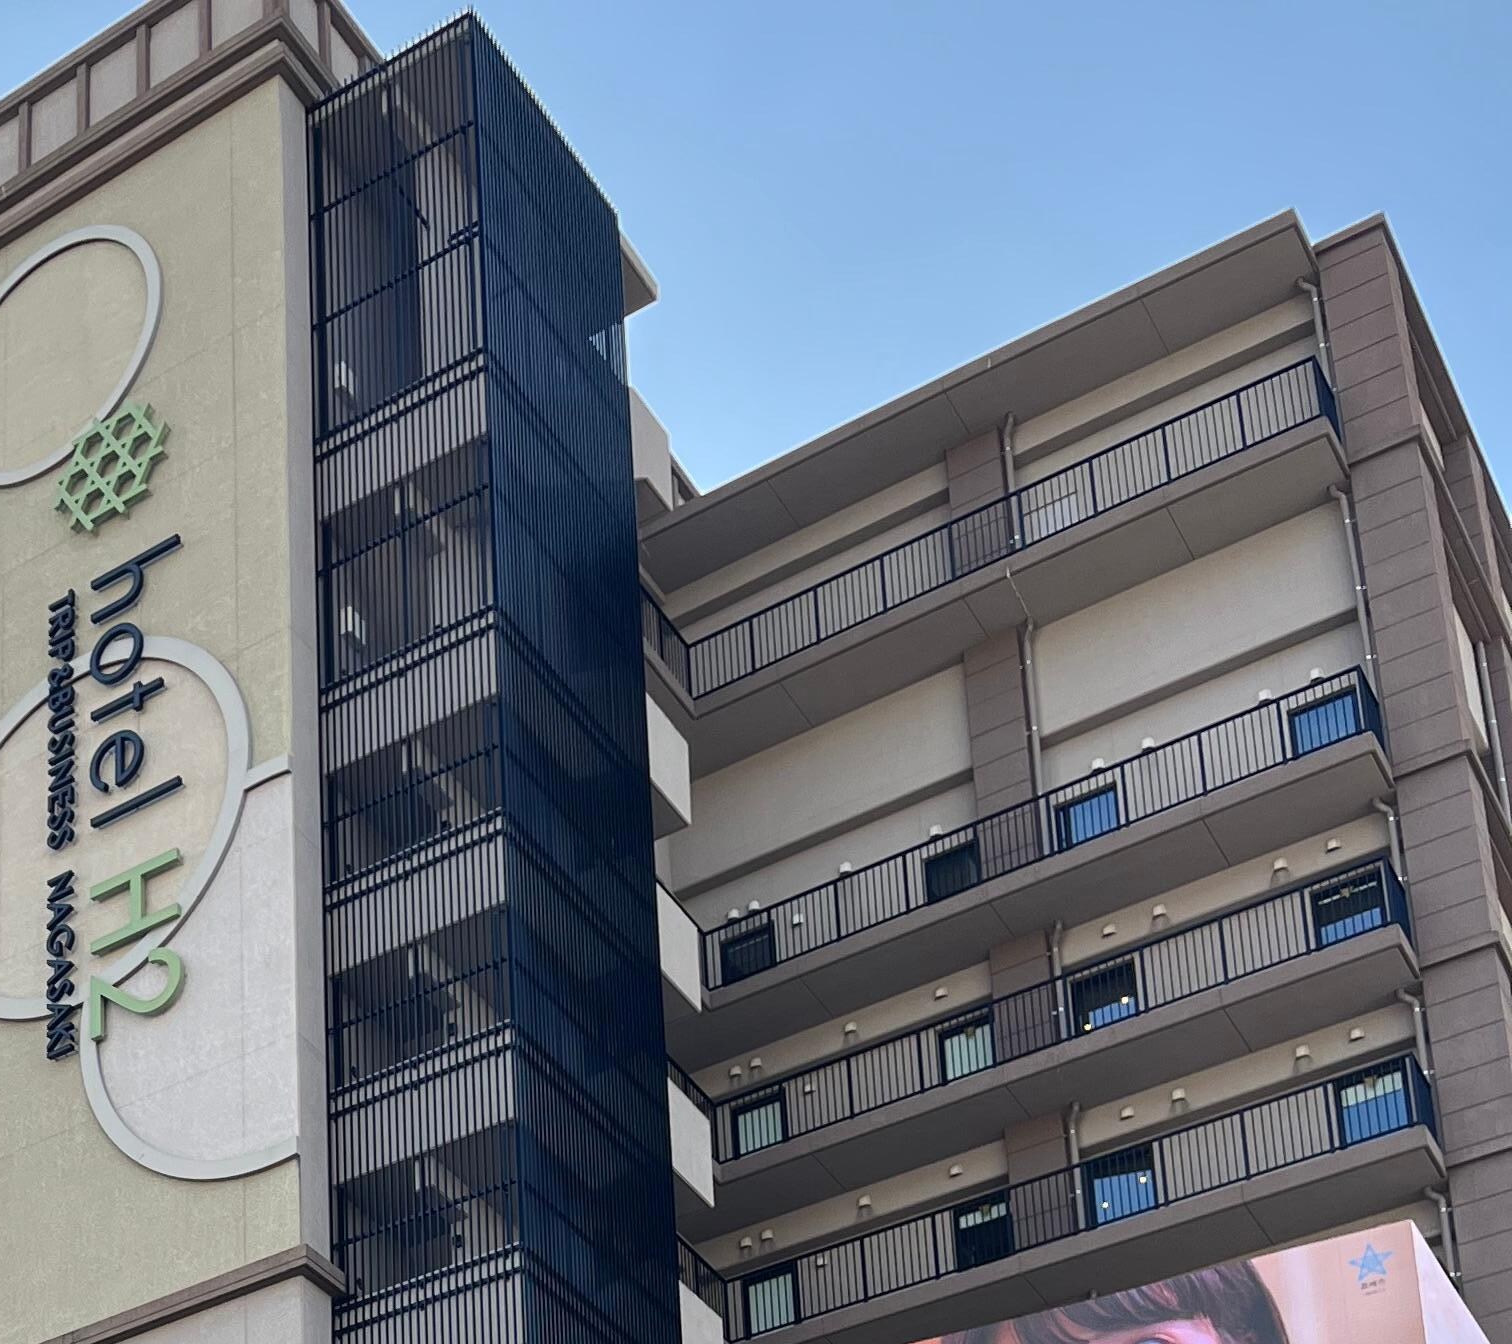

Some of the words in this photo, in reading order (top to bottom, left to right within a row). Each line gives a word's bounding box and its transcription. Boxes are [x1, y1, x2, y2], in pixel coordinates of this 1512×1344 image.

[90, 533, 185, 830] hotel
[46, 869, 76, 1061] NAGASAKI
[90, 847, 186, 1042] H2
